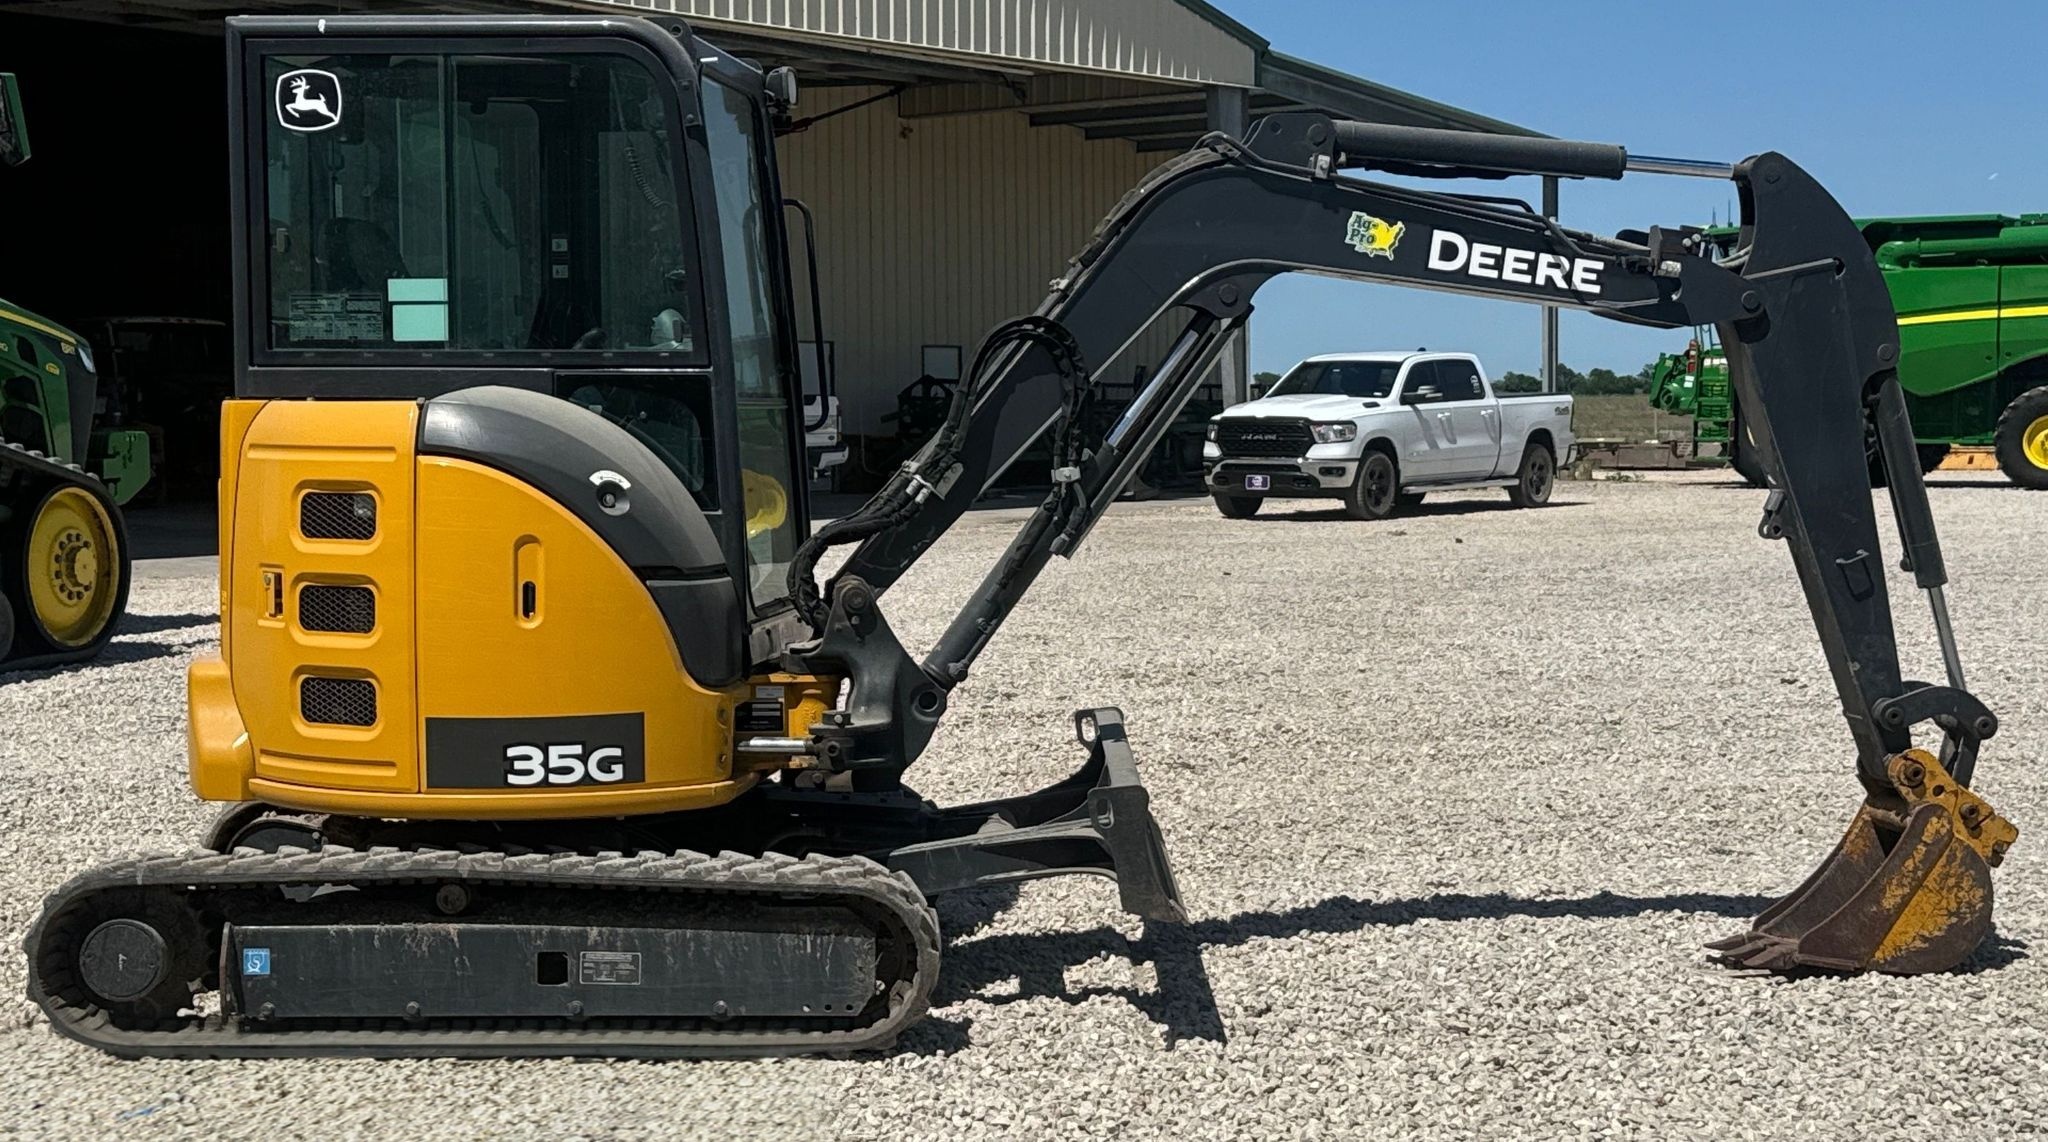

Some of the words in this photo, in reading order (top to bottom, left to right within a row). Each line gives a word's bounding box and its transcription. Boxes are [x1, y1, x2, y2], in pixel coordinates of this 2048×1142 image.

[1349, 228, 1376, 244] Pro
[1428, 229, 1605, 294] DEERE
[506, 744, 624, 785] 35G
